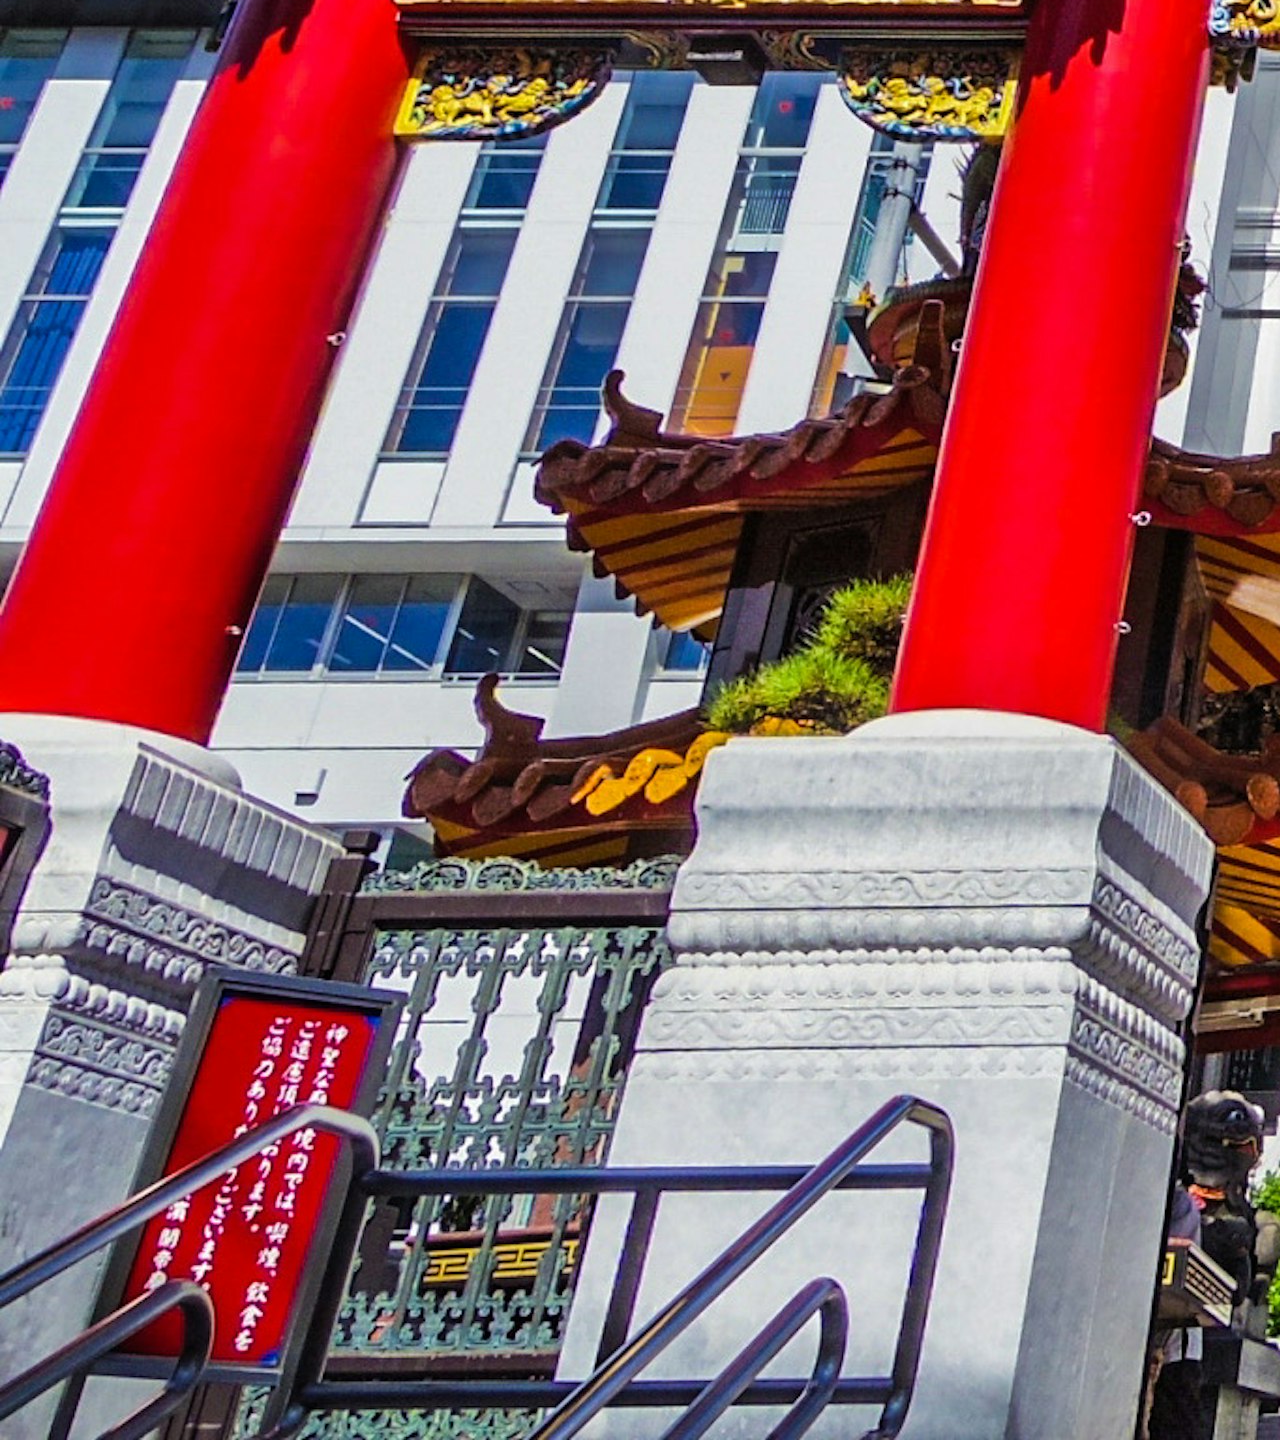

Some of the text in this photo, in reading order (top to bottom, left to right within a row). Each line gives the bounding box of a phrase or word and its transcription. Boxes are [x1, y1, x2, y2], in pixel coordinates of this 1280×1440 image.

[234, 1023, 349, 1352] 神聖な廟境内では、喫煙、飲食を
